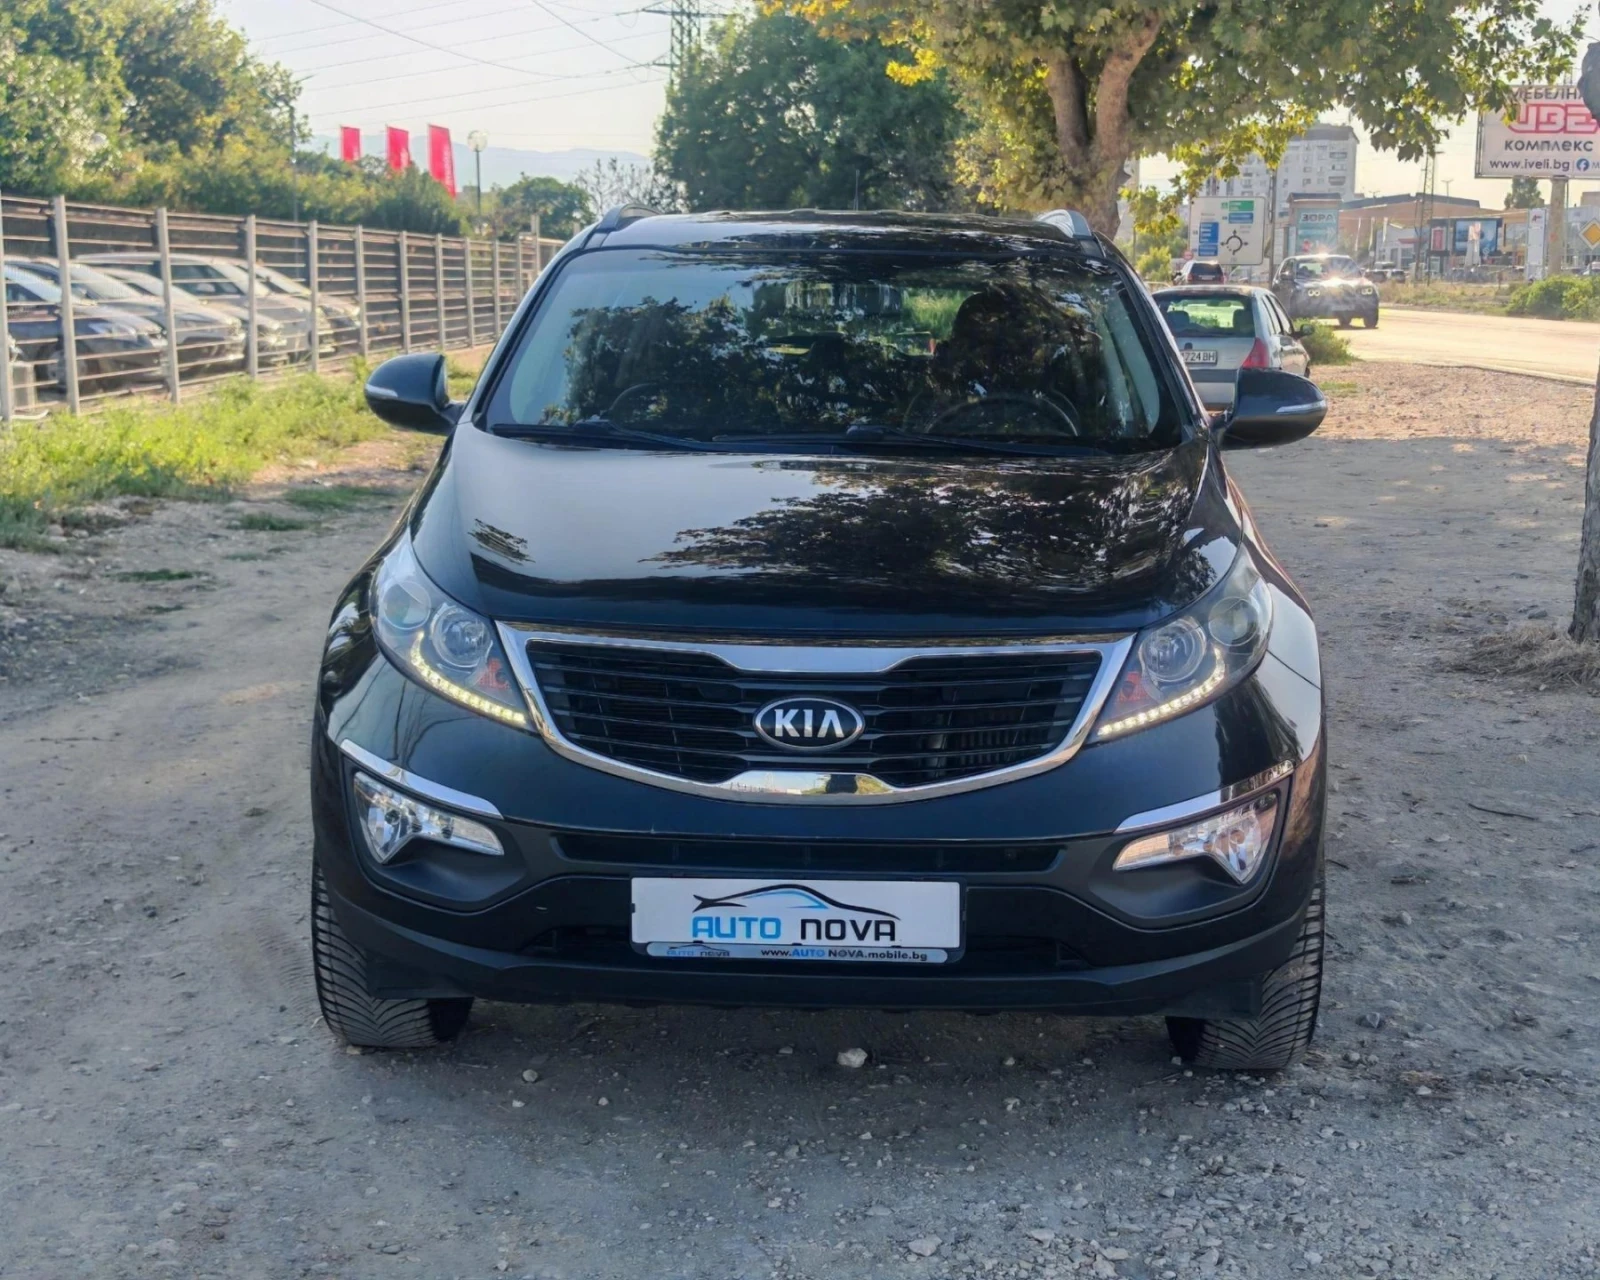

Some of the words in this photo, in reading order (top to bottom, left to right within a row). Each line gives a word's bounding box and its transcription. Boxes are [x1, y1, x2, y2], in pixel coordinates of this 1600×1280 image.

[1510, 87, 1583, 100] МЕБЕЛН
[1489, 158, 1570, 172] www.iveli.bg
[774, 708, 845, 738] KIA
[692, 916, 782, 940] AUTO
[800, 918, 897, 942] NOVA
